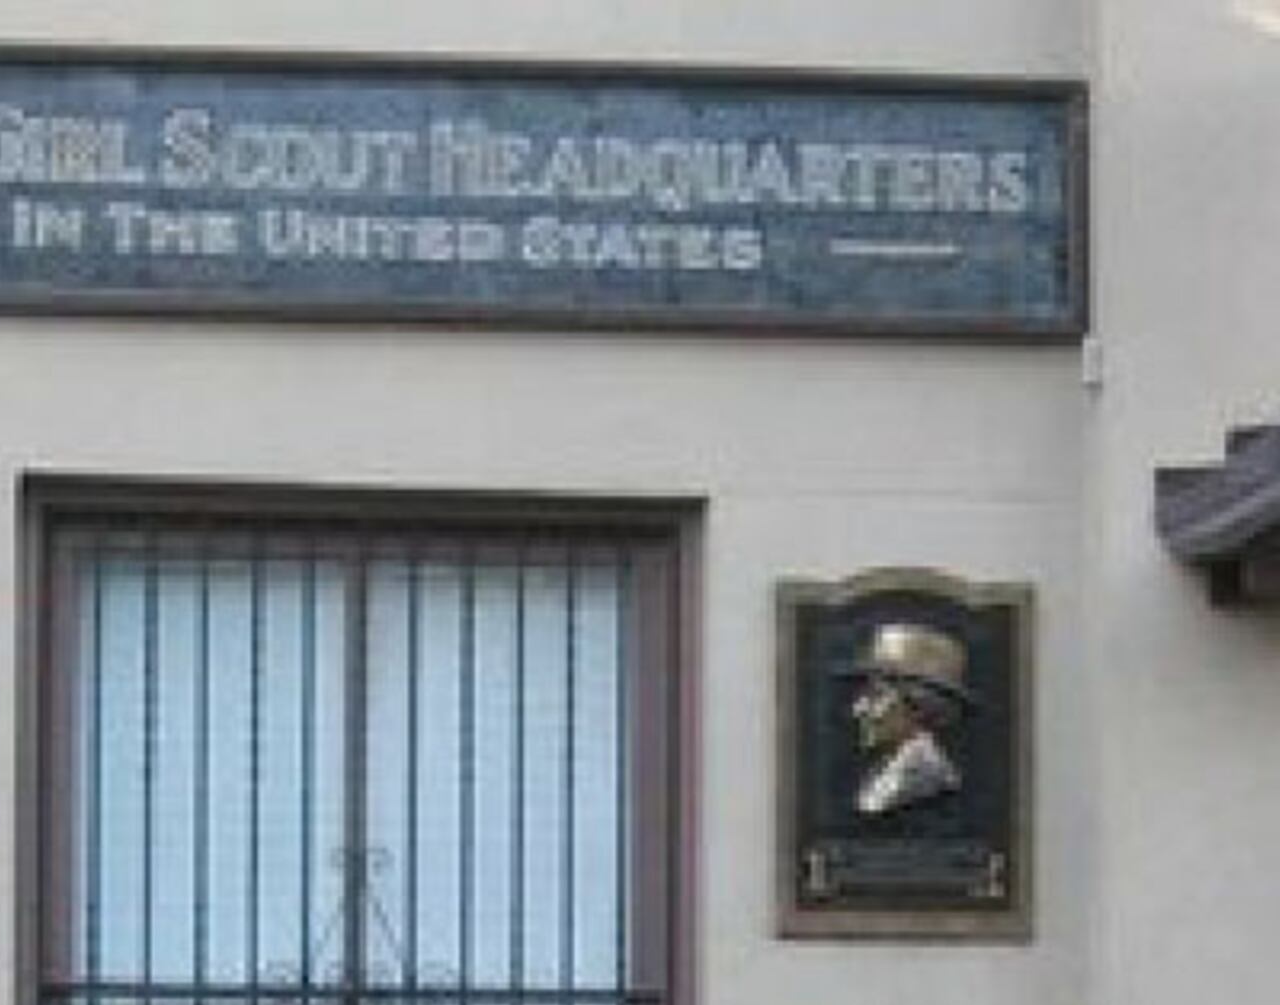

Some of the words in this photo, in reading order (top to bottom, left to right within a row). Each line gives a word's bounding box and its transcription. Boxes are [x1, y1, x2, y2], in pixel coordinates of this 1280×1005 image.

[162, 108, 418, 191] SCOUT
[429, 120, 1027, 211] HEADQUARTERS
[13, 196, 85, 249] IN
[106, 201, 239, 255] THE
[261, 210, 504, 260] UNITED
[519, 216, 763, 270] STATES
